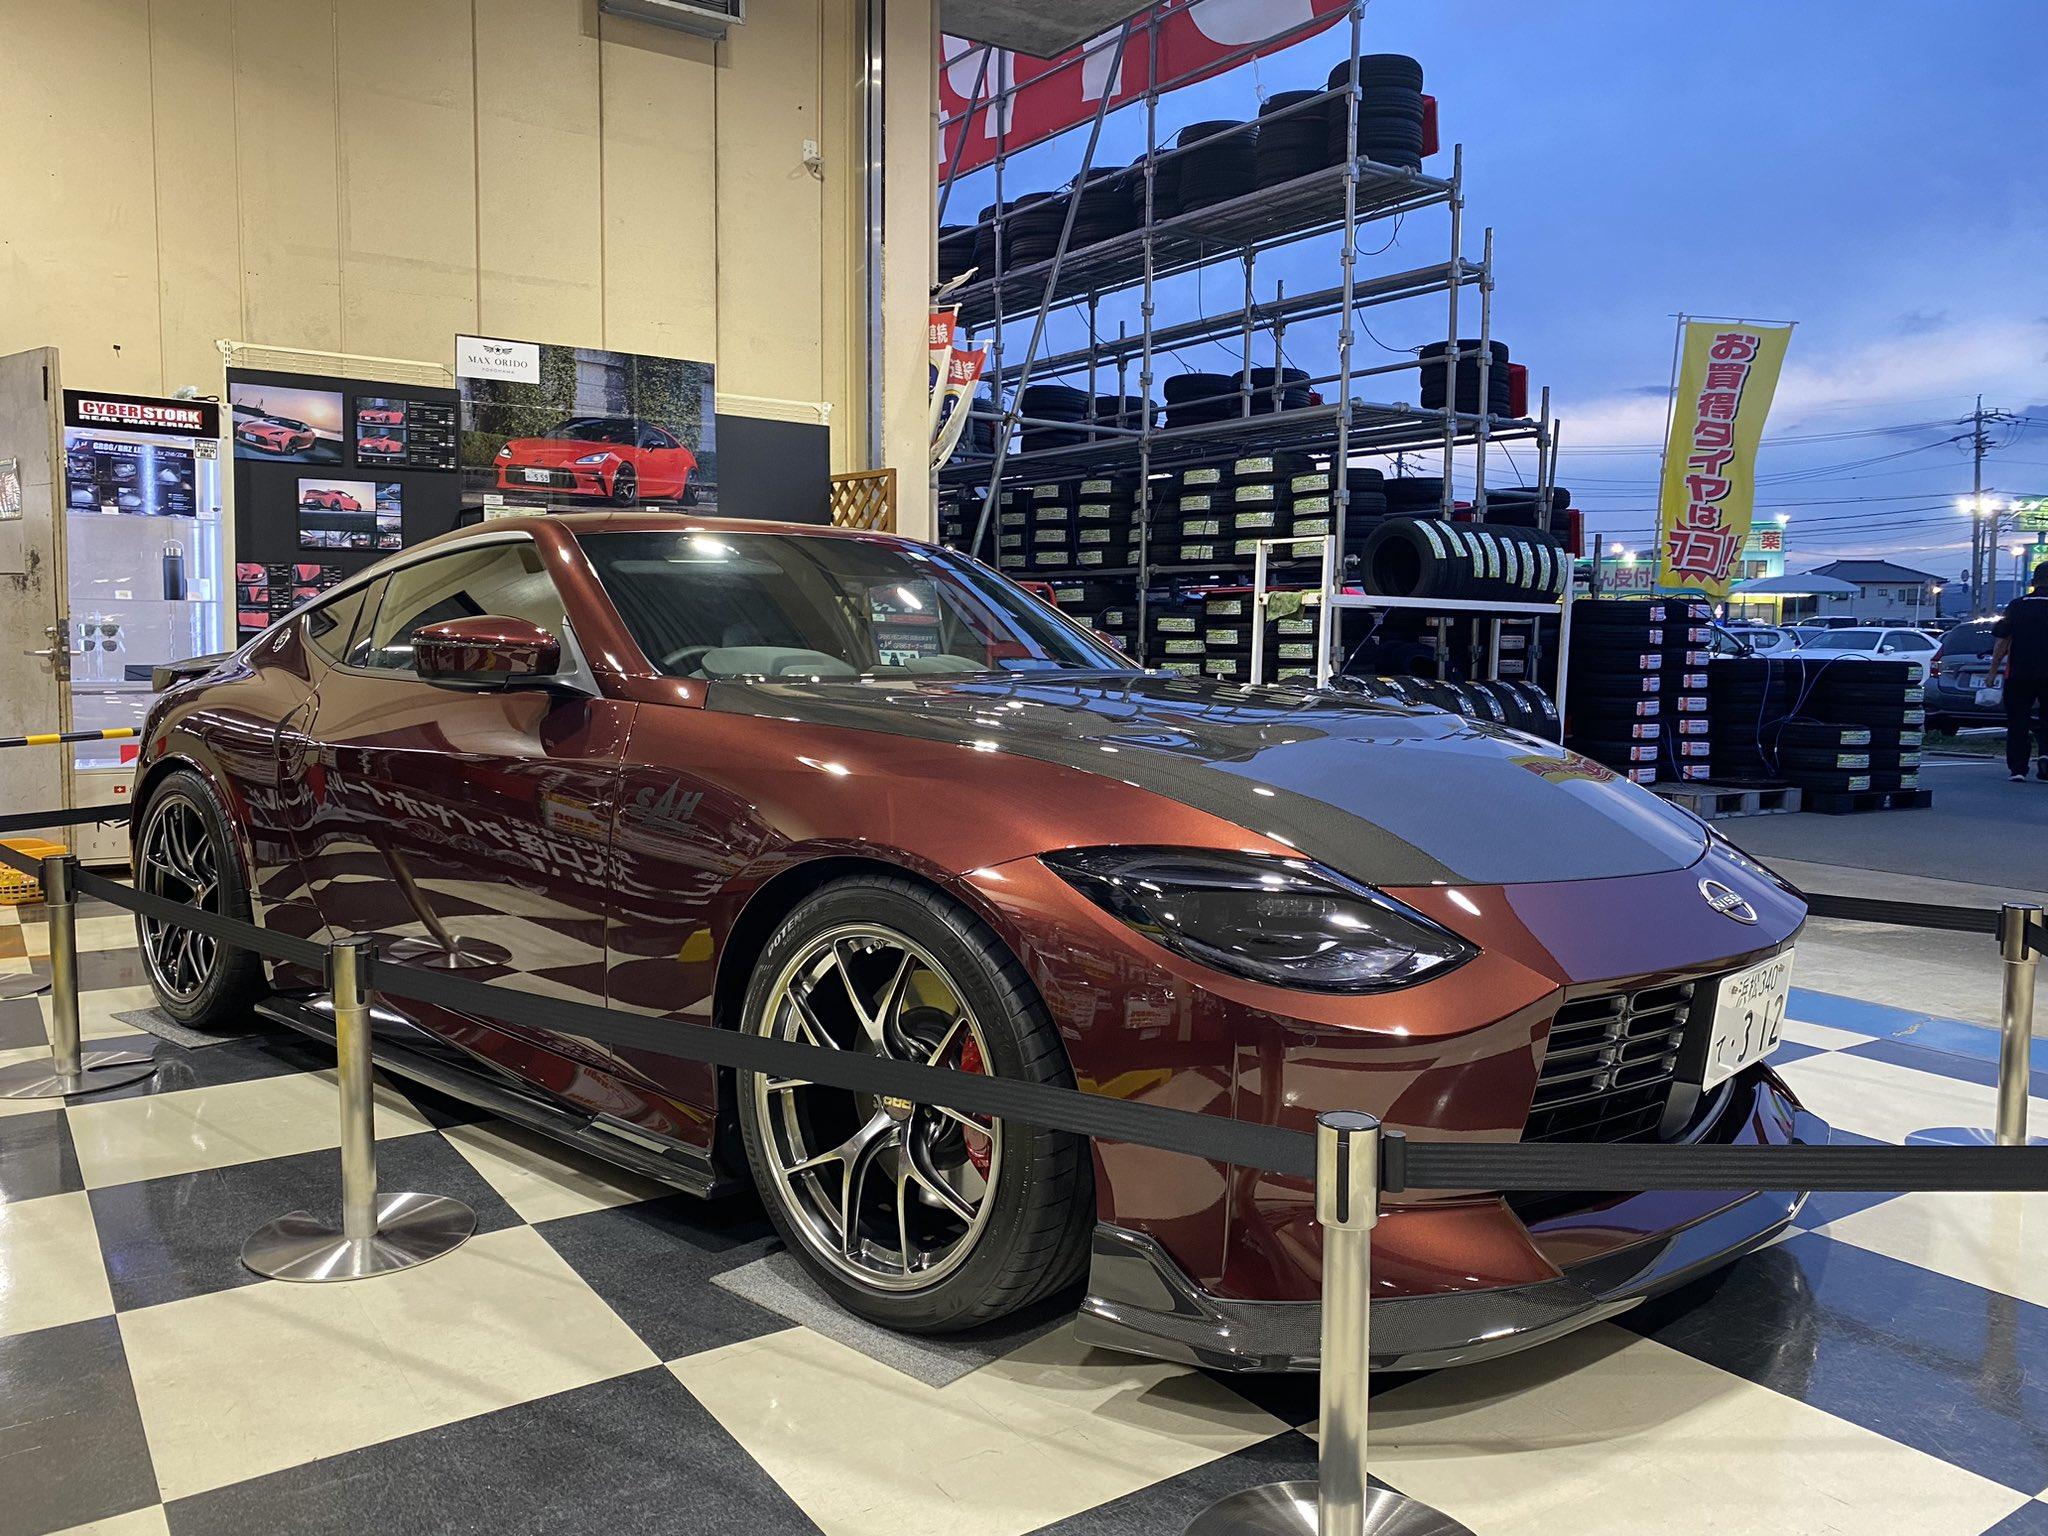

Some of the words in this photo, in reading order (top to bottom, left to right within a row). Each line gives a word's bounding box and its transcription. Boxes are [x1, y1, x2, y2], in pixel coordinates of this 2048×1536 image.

[468, 355, 490, 365] MAX
[494, 358, 528, 368] ORIDO
[83, 402, 139, 417] CYBER
[143, 406, 200, 422] STORK
[1758, 965, 1778, 997] 340
